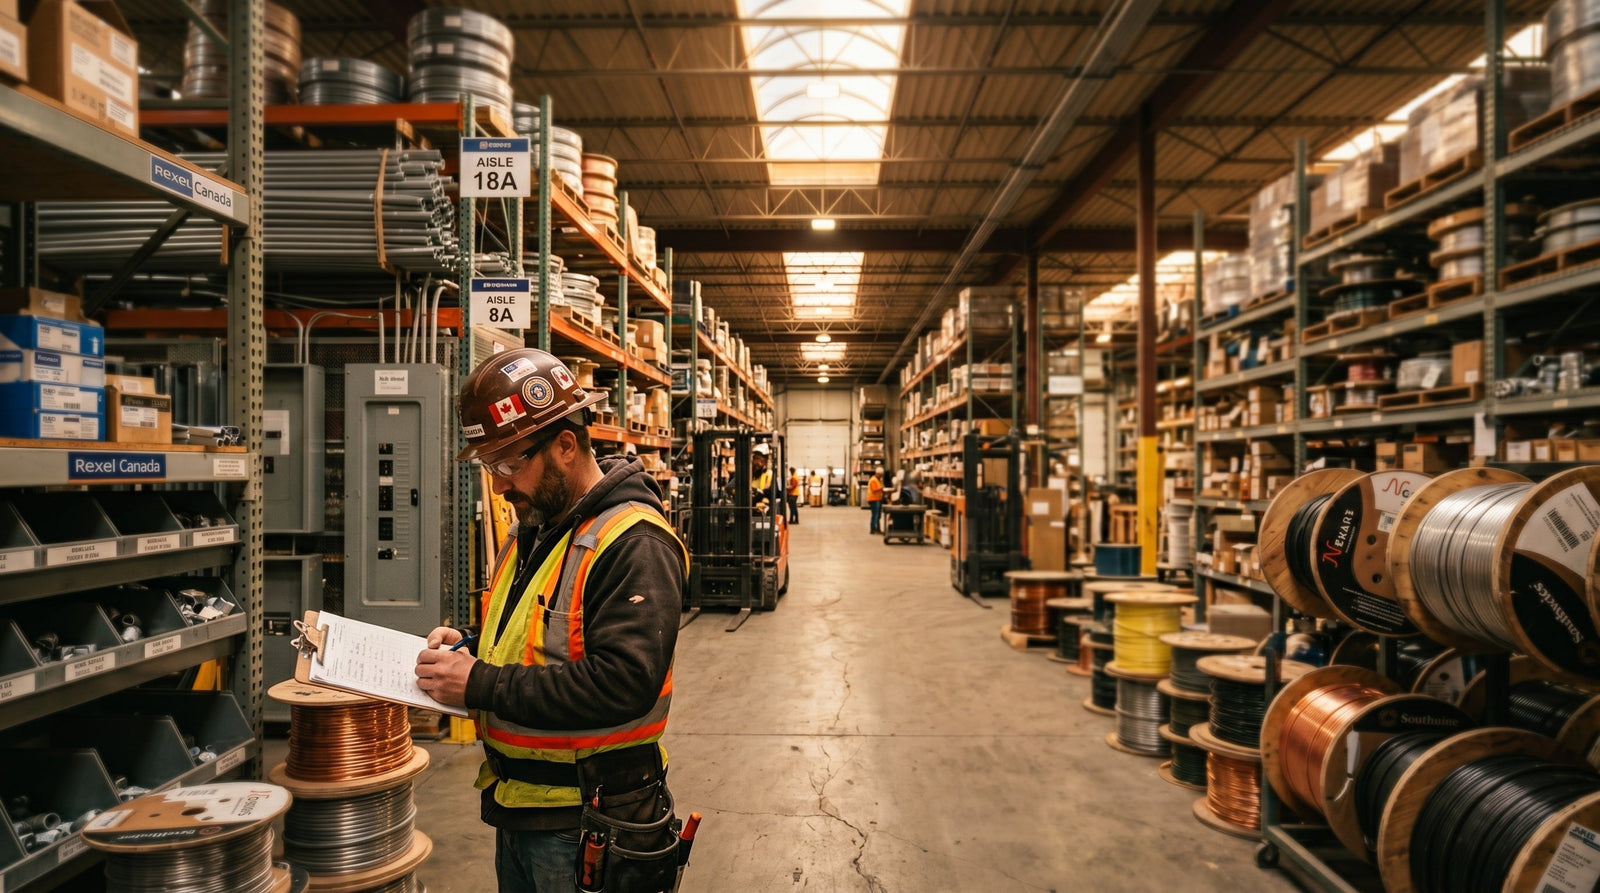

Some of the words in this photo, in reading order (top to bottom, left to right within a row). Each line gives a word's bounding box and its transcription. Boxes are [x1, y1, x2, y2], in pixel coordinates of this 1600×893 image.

[476, 157, 514, 168] AISLE
[473, 171, 518, 191] 18A
[194, 181, 232, 208] Canada
[486, 296, 516, 305] AISLE
[489, 307, 514, 323] 8A
[75, 458, 116, 473] Rexel
[119, 459, 161, 473] Canada
